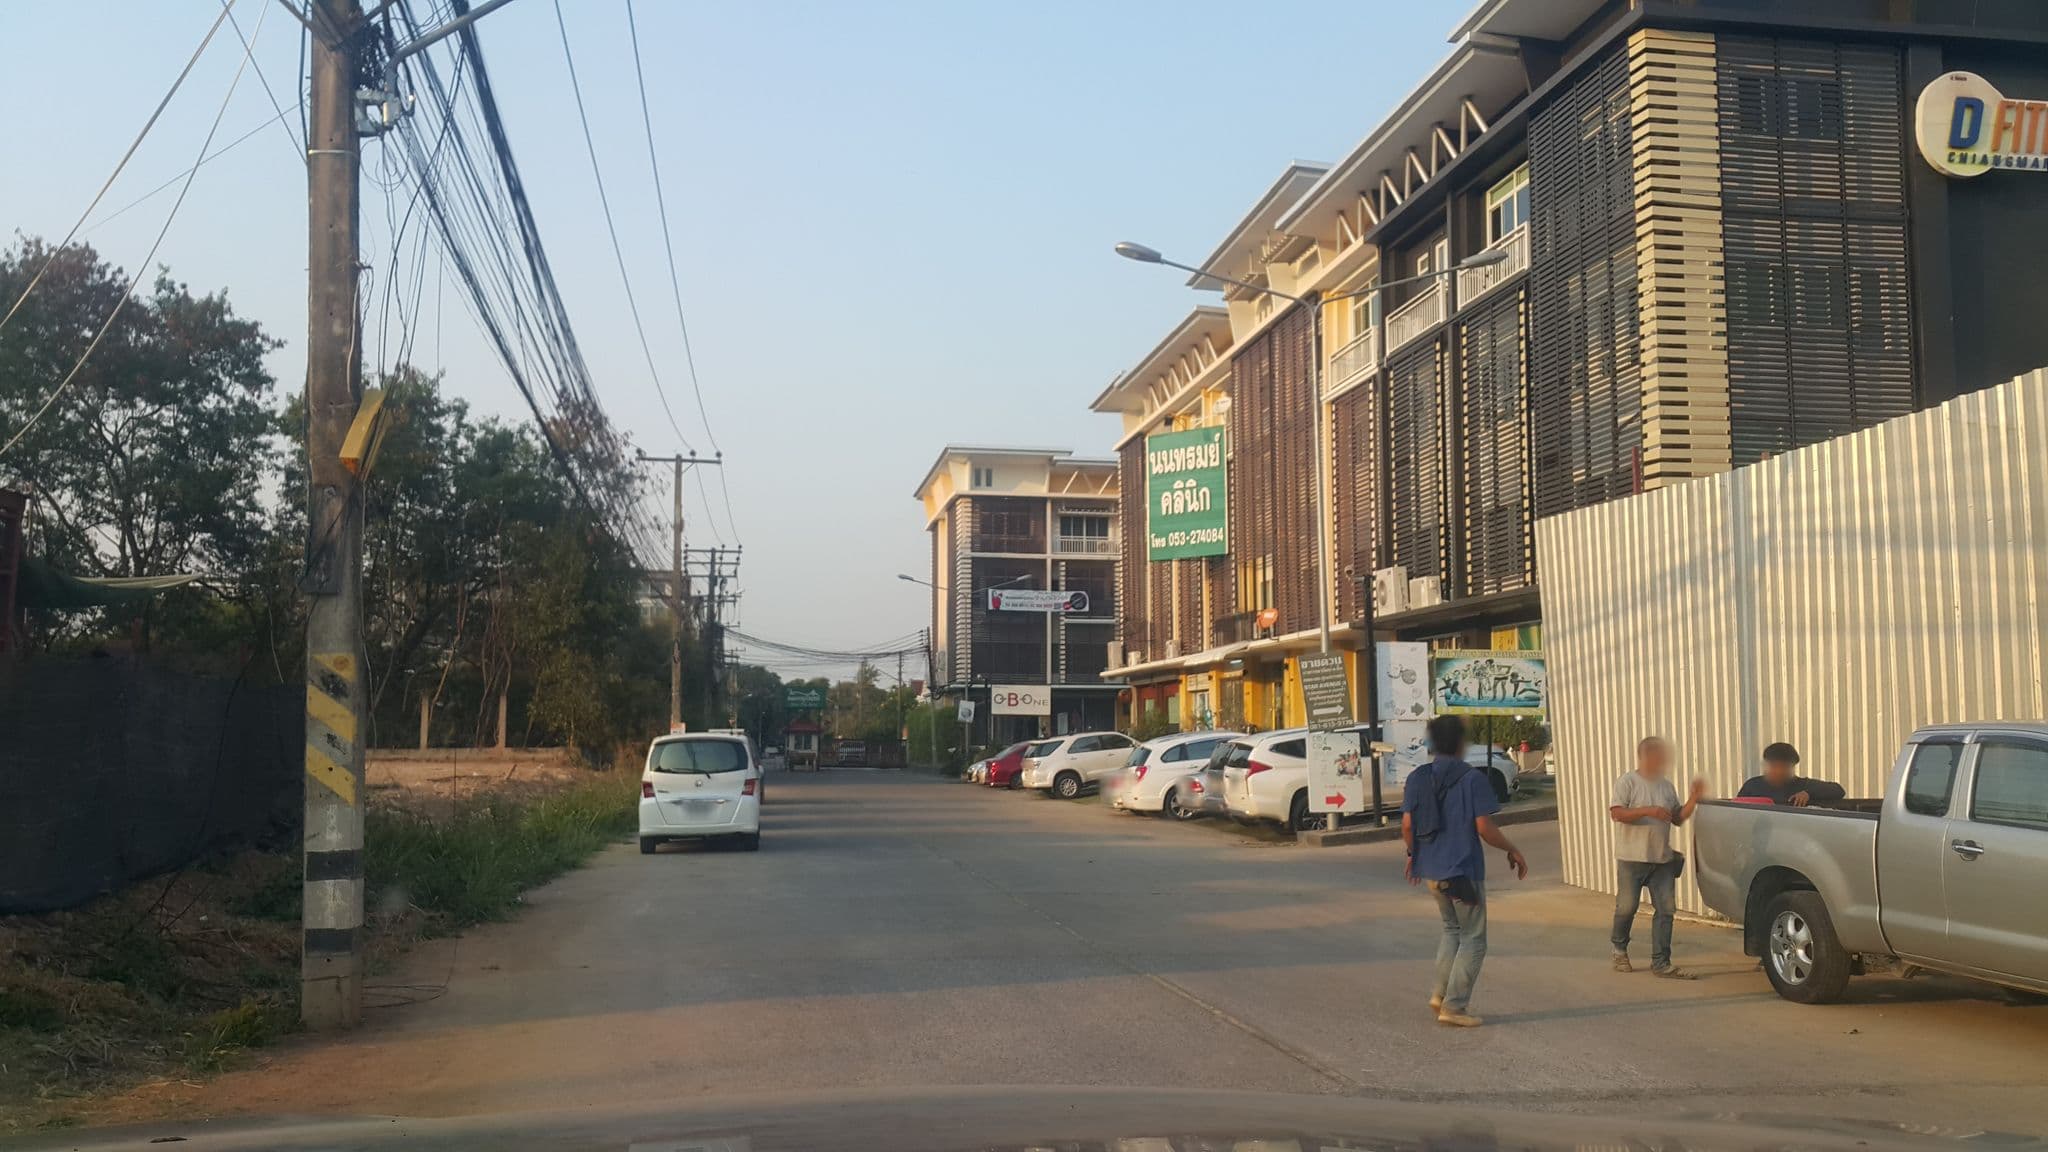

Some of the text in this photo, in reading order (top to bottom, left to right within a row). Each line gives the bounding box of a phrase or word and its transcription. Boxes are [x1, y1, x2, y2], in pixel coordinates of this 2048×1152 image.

[1948, 97, 2048, 155] D FIT
[1161, 479, 1211, 516] คลินิก
[1168, 527, 1224, 547] 053-274084
